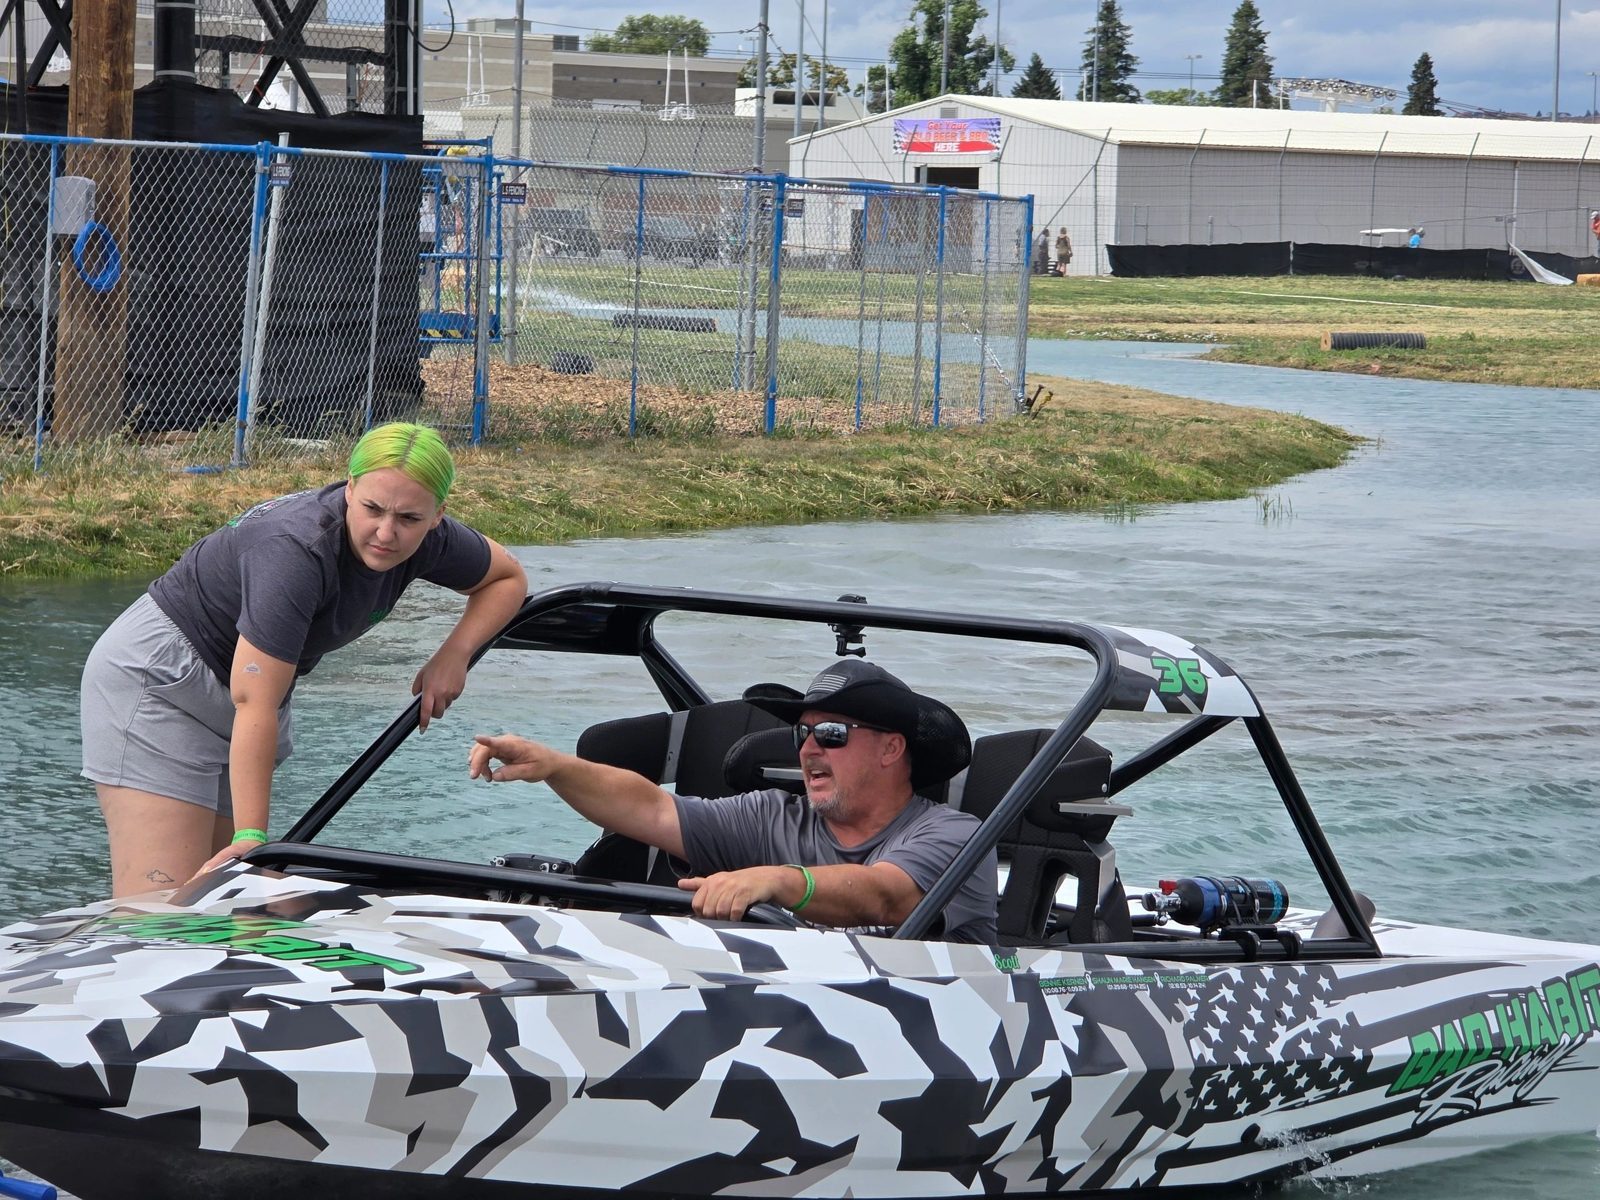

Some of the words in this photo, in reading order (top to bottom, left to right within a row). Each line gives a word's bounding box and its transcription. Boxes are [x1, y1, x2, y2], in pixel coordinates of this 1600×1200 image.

[928, 120, 943, 130] Get
[945, 120, 968, 130] Your
[934, 131, 958, 141] BEER
[934, 142, 960, 152] HERE
[1150, 656, 1209, 697] 36
[994, 953, 1020, 969] Scott
[1160, 975, 1185, 983] RICHARD
[1385, 1012, 1493, 1097] BAD
[1411, 1032, 1585, 1128] Racing
